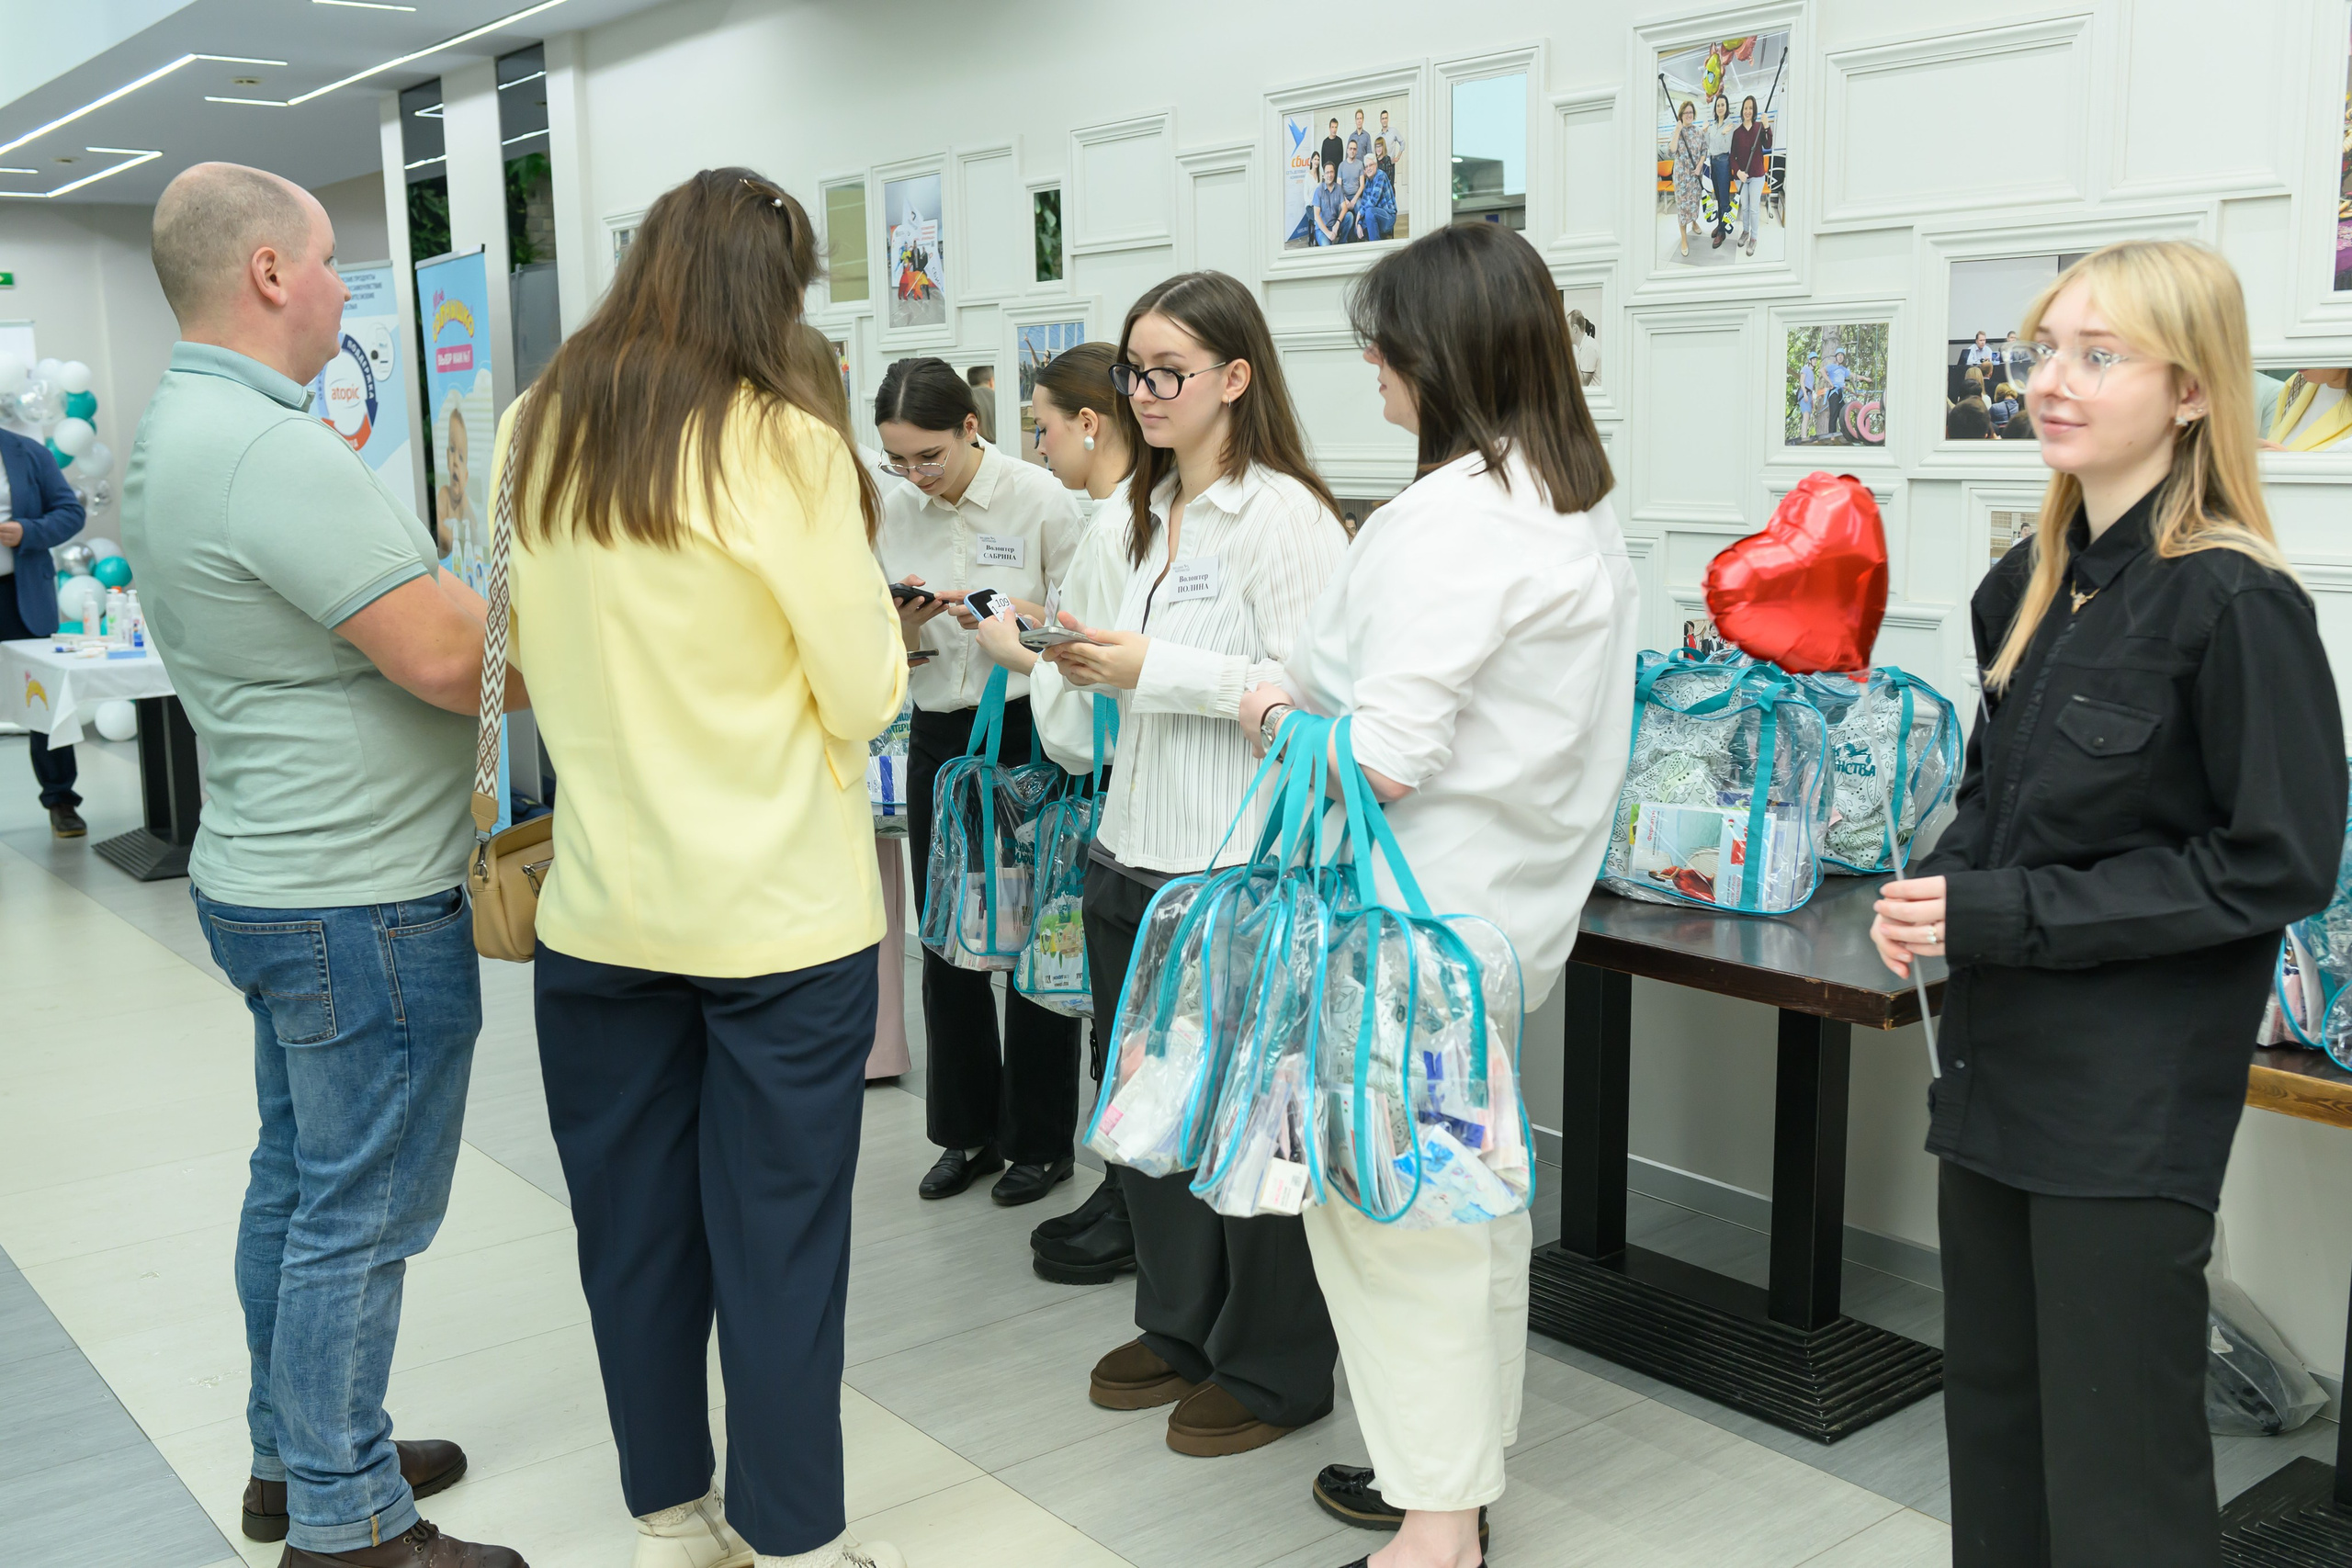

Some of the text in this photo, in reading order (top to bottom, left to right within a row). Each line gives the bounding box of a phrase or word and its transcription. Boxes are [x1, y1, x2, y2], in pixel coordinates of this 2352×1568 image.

[346, 339, 375, 400] ПОДДЕРЖКА
[331, 384, 360, 402] atopic
[986, 545, 1015, 554] Волонтер
[983, 552, 1017, 560] САБРИНА
[1179, 573, 1209, 583] Волонтер
[1177, 583, 1209, 593] ПОЛИНА
[995, 597, 1010, 608] 109
[1834, 759, 1876, 777] НСТВА
